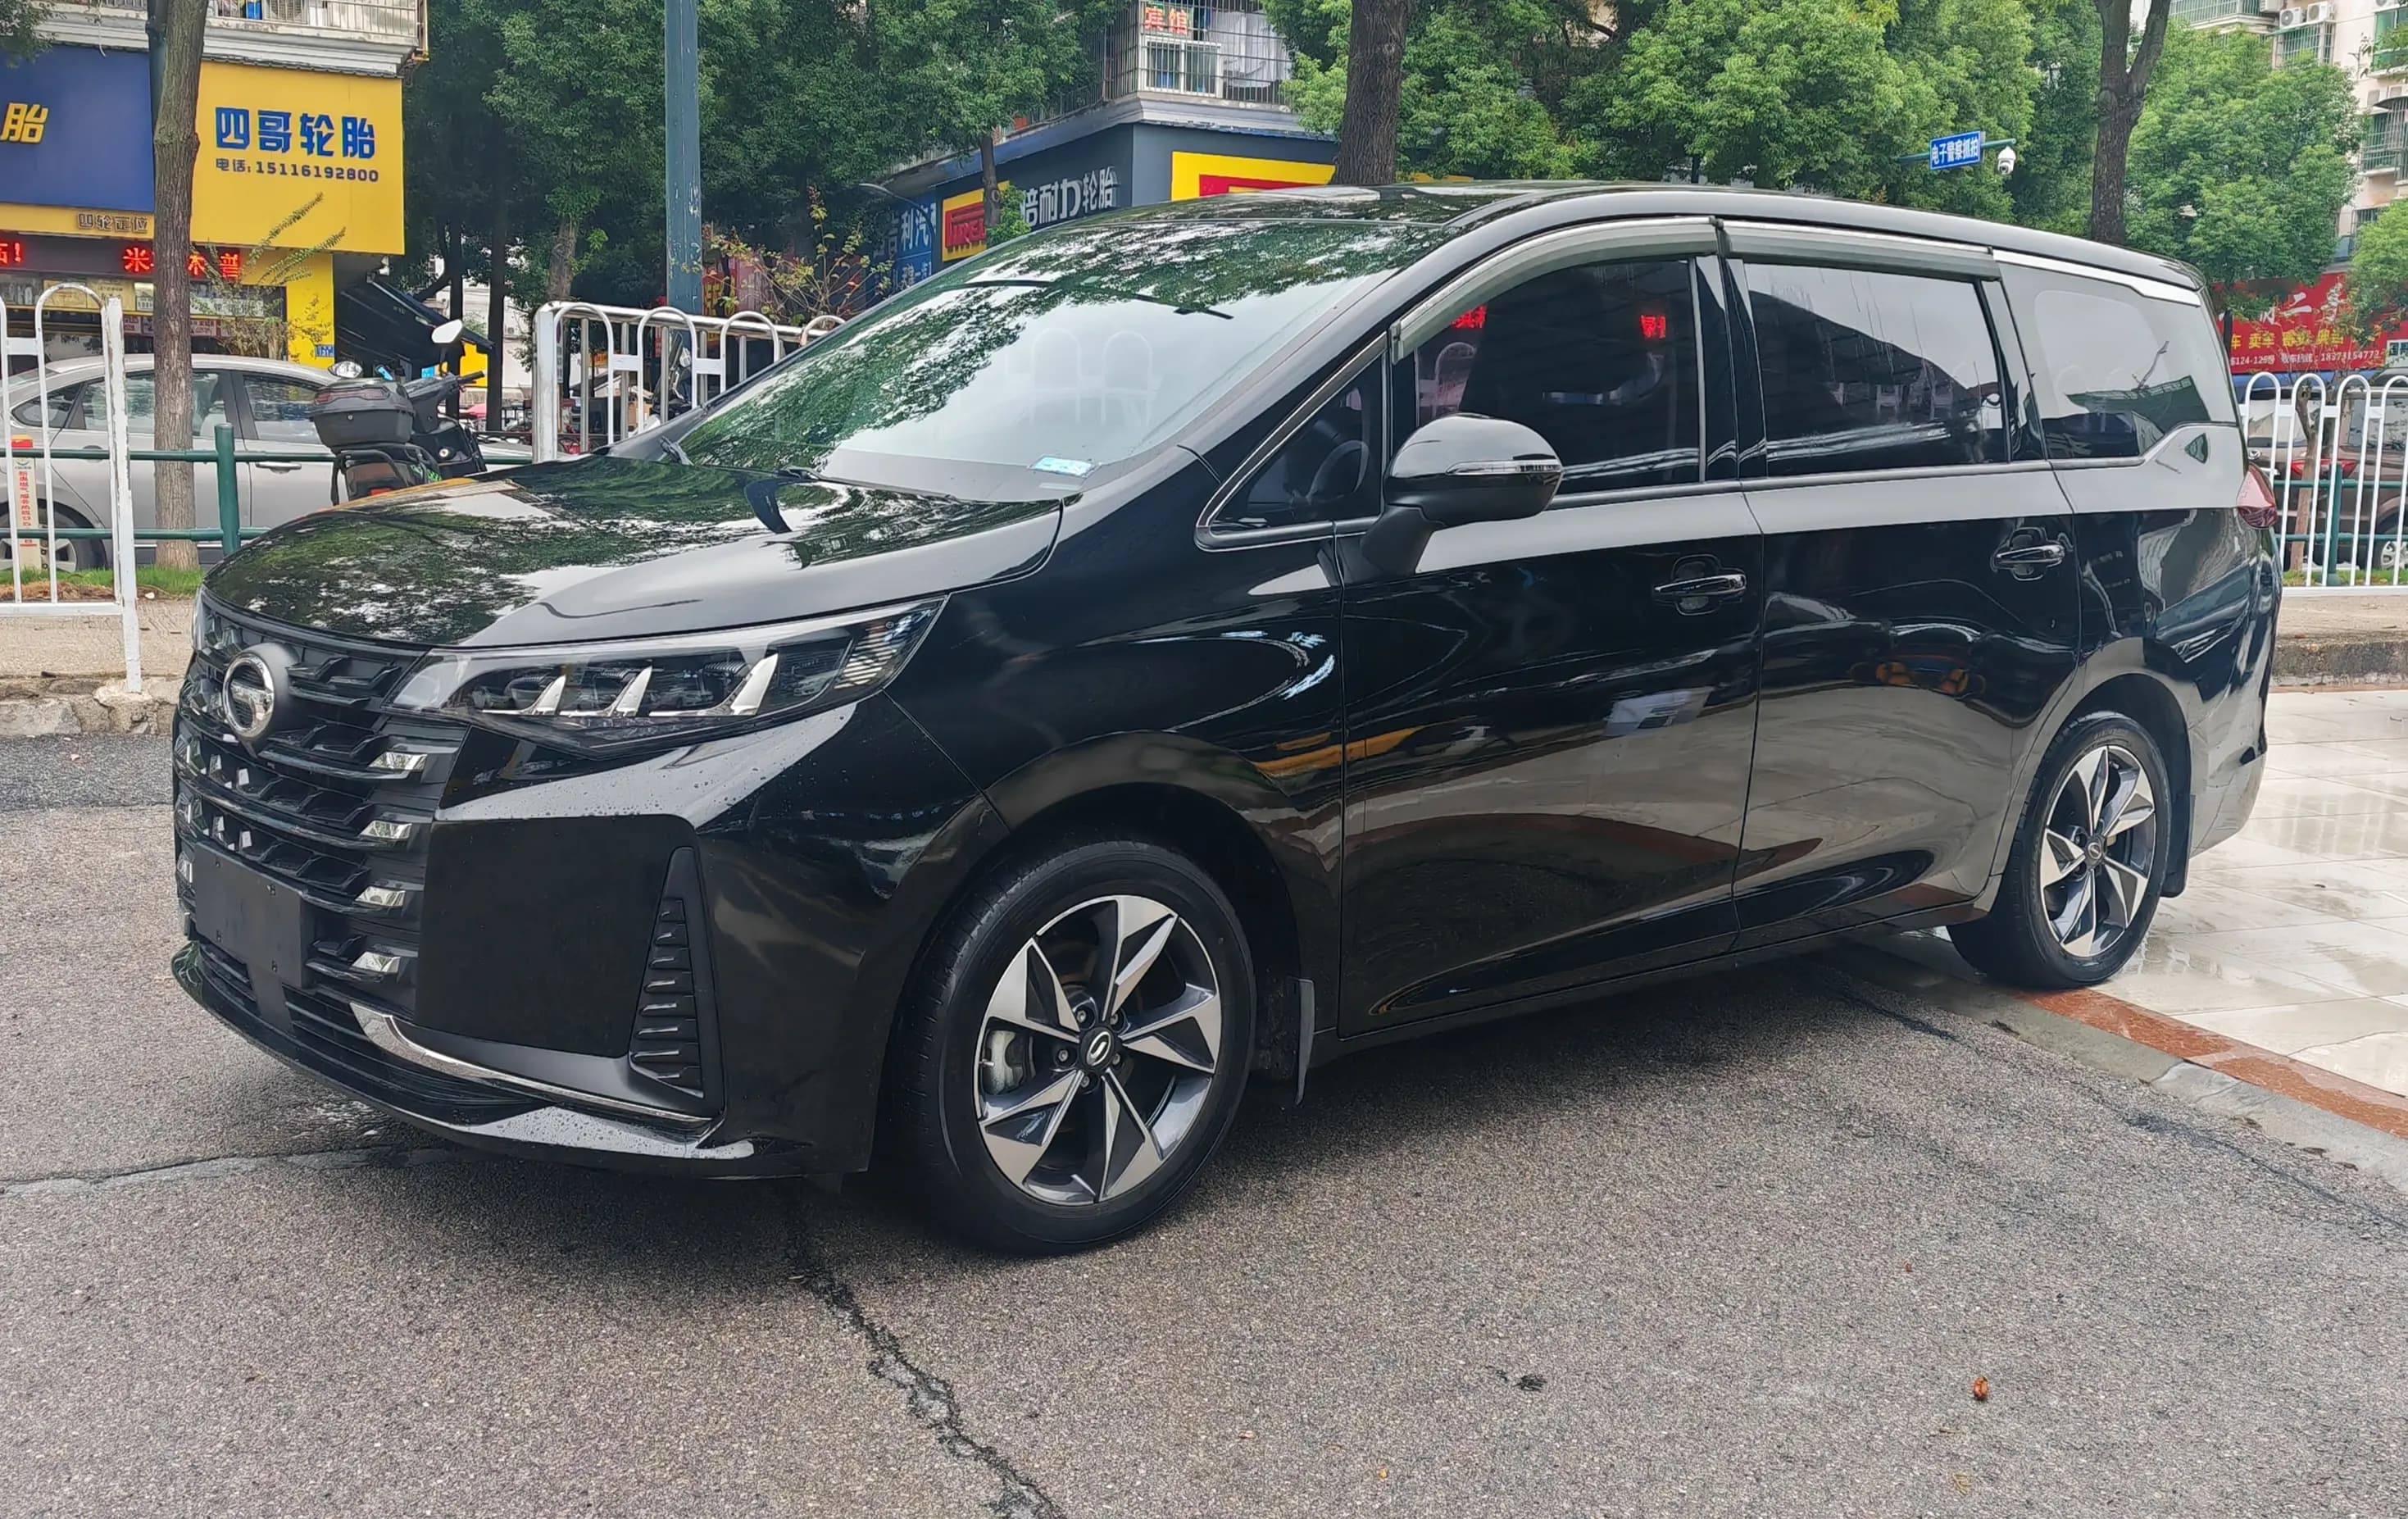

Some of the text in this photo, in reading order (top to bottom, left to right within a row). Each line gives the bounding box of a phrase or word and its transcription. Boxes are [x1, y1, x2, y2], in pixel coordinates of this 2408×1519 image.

[1144, 6, 1188, 34] 宾馆
[0, 102, 49, 145] 胎
[215, 107, 375, 159] 四哥轮胎
[1932, 136, 1979, 165] 电子警察抓拍
[78, 213, 148, 233] 四轮定位
